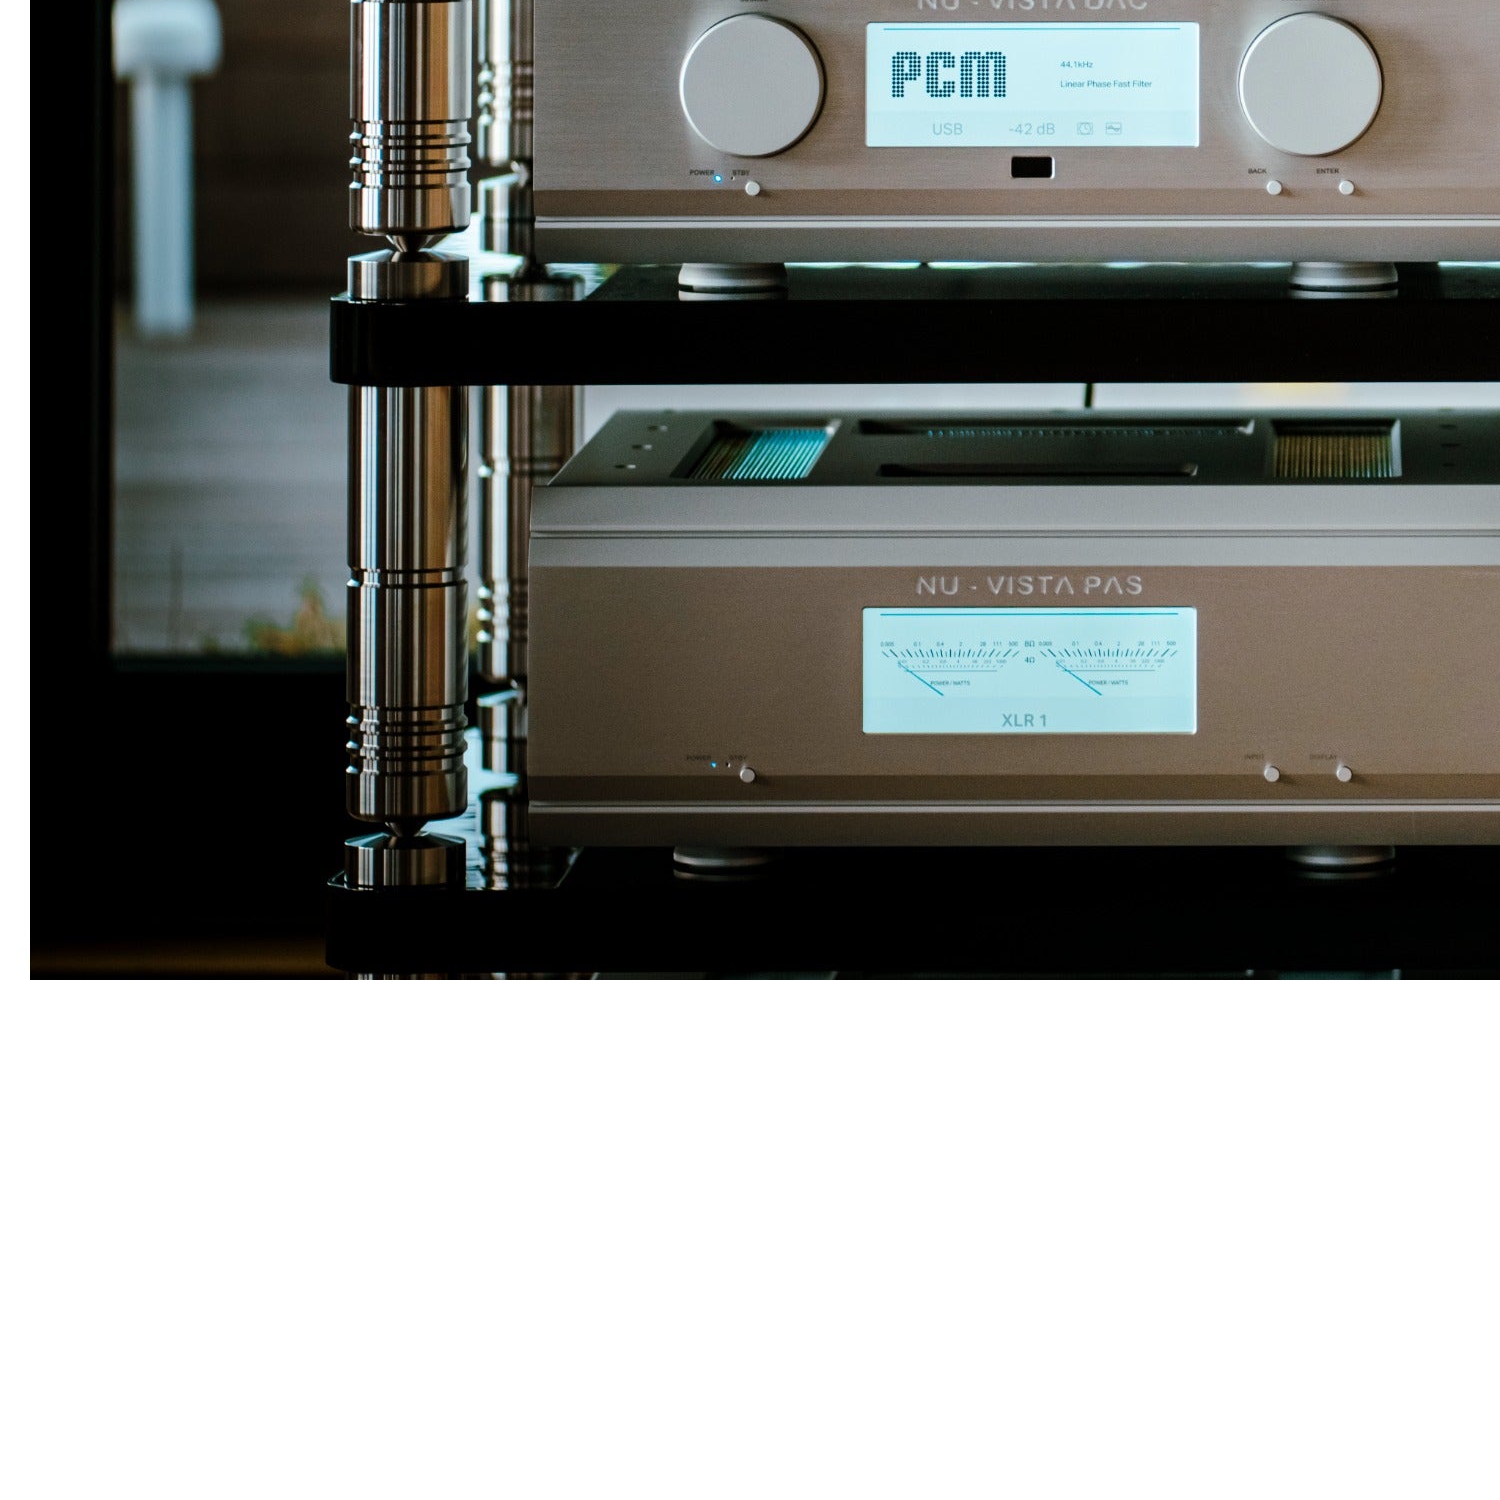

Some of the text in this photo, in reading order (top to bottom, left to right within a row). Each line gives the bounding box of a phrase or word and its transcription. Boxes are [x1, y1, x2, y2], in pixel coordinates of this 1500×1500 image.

[892, 52, 1006, 97] PCM
[1060, 80, 1152, 88] Linear Phase Fast Filter
[933, 122, 1056, 135] USB -42 dB
[916, 576, 959, 595] NU
[987, 576, 1074, 595] VISTA
[1085, 576, 1143, 595] PAS
[1002, 714, 1047, 727] XLR 1
